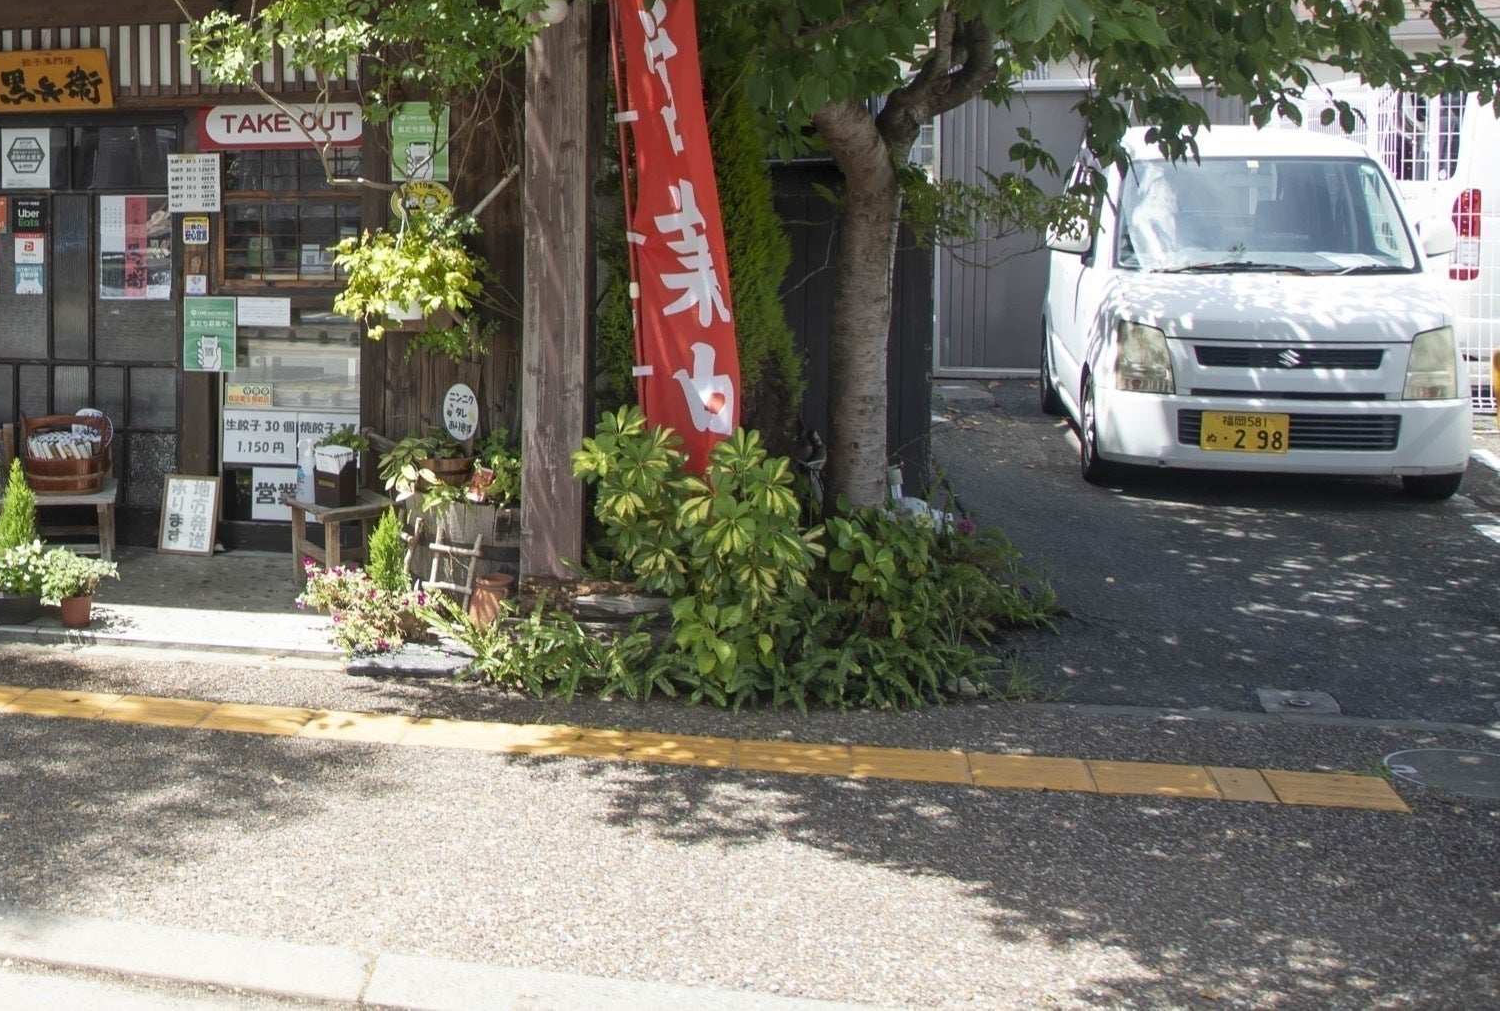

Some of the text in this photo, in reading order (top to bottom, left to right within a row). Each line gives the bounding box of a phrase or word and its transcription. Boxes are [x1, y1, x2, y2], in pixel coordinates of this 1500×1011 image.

[0, 66, 103, 105] 黒兵衛
[220, 110, 354, 133] TAKE OUT
[18, 209, 39, 218] Uber
[18, 218, 39, 227] Eats
[449, 392, 474, 405] ニンニク
[226, 419, 295, 433] 生餃子 30 個
[300, 421, 336, 434] 焼餃子
[273, 442, 285, 453] 円
[168, 479, 187, 543] 承ります
[189, 480, 210, 549] 地方発送
